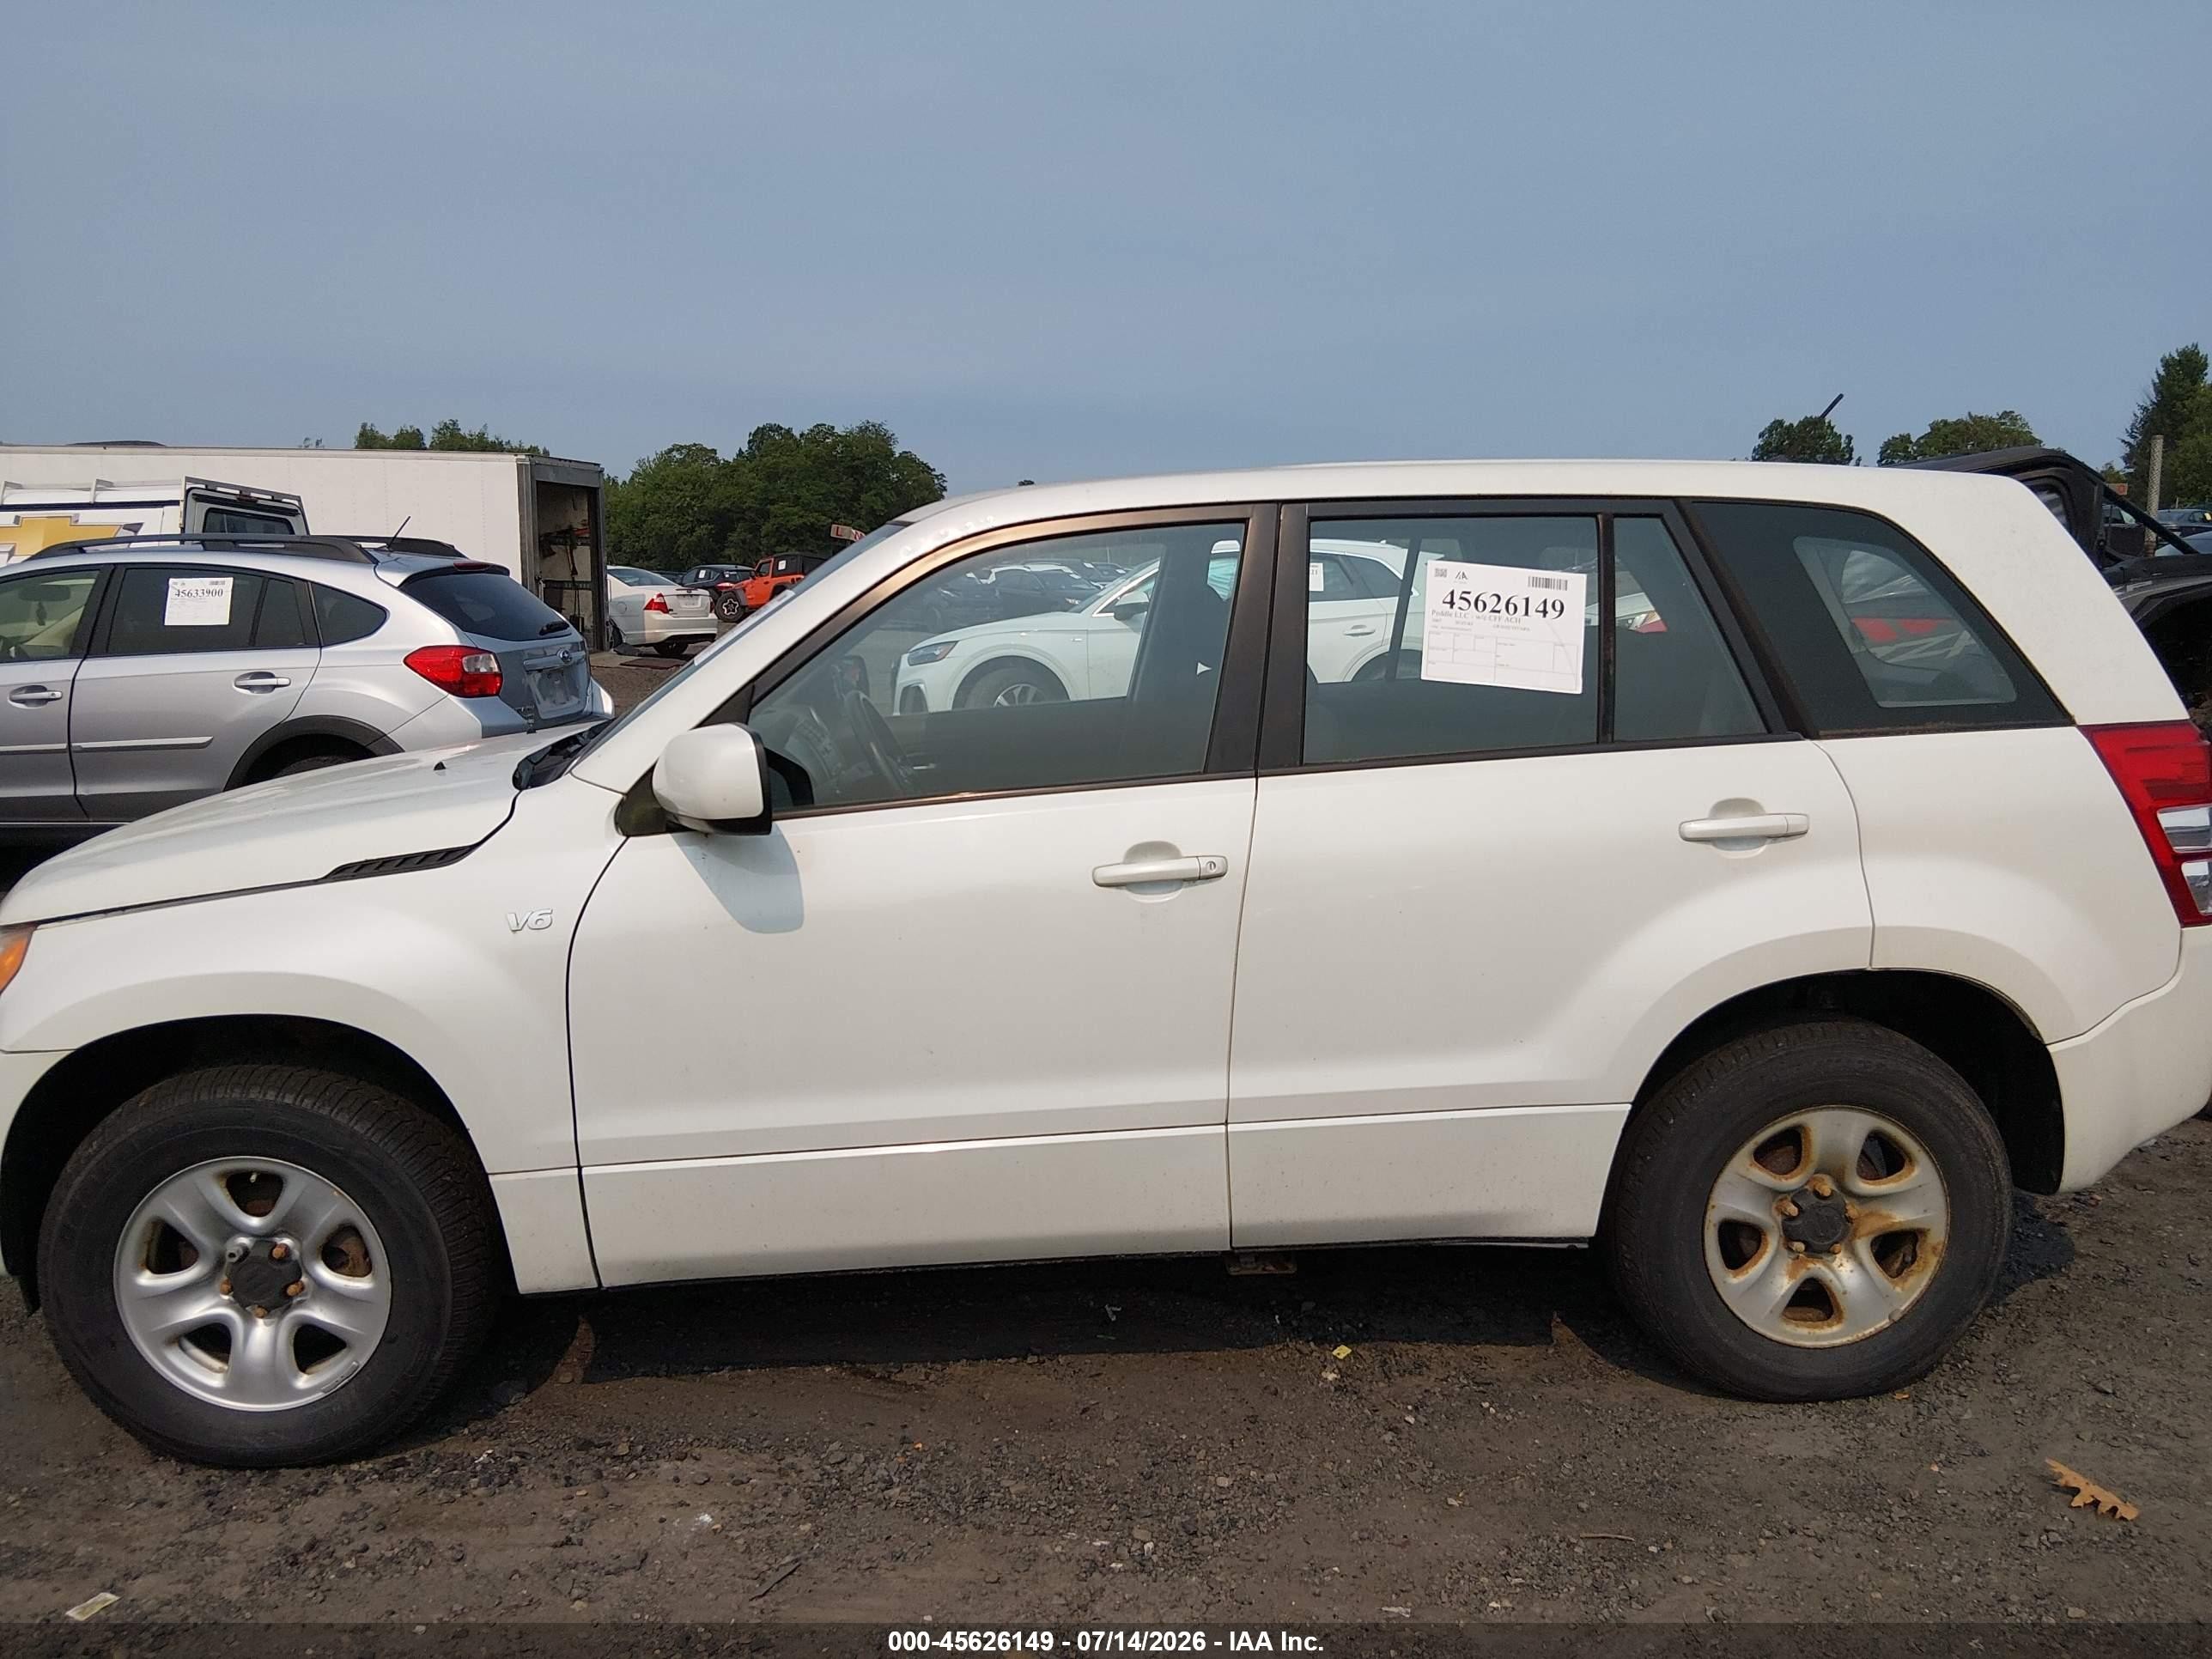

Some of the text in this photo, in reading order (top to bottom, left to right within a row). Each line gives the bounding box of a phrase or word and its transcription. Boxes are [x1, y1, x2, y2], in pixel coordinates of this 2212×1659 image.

[175, 588, 223, 598] 45633900
[1443, 589, 1565, 619] 45626149
[507, 908, 552, 932] V6
